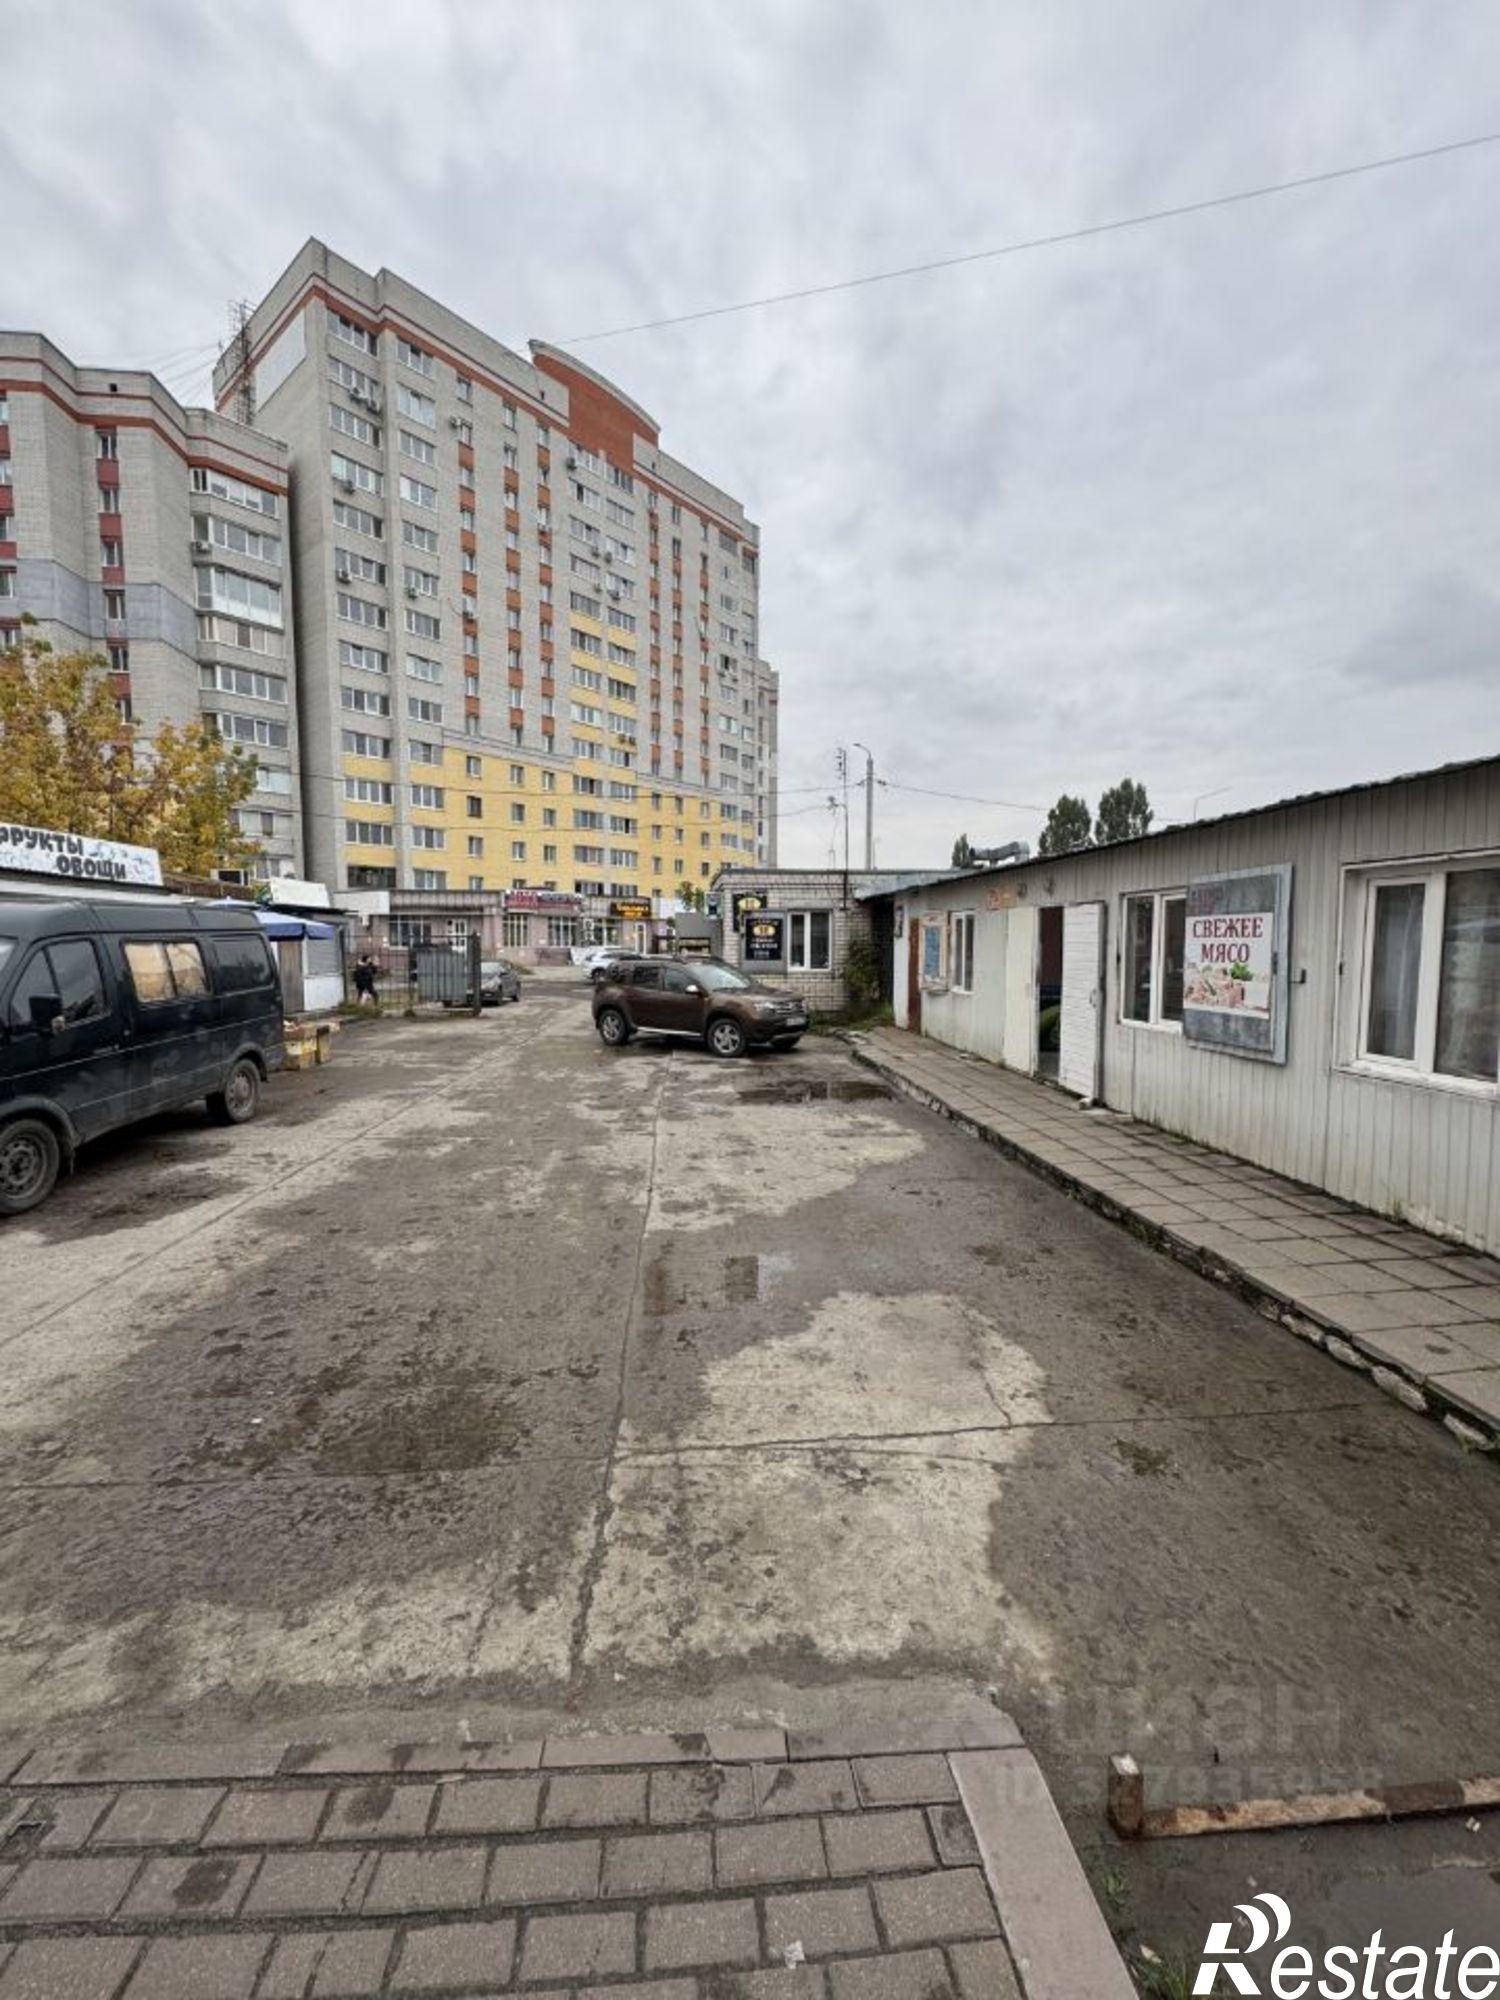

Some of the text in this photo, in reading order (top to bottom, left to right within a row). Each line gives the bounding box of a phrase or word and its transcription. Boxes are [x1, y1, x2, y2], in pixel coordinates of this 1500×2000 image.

[56, 856, 127, 880] ОВОЩИ
[1192, 917, 1263, 939] СВЕЖЕЕ
[1201, 943, 1250, 963] МЯСО
